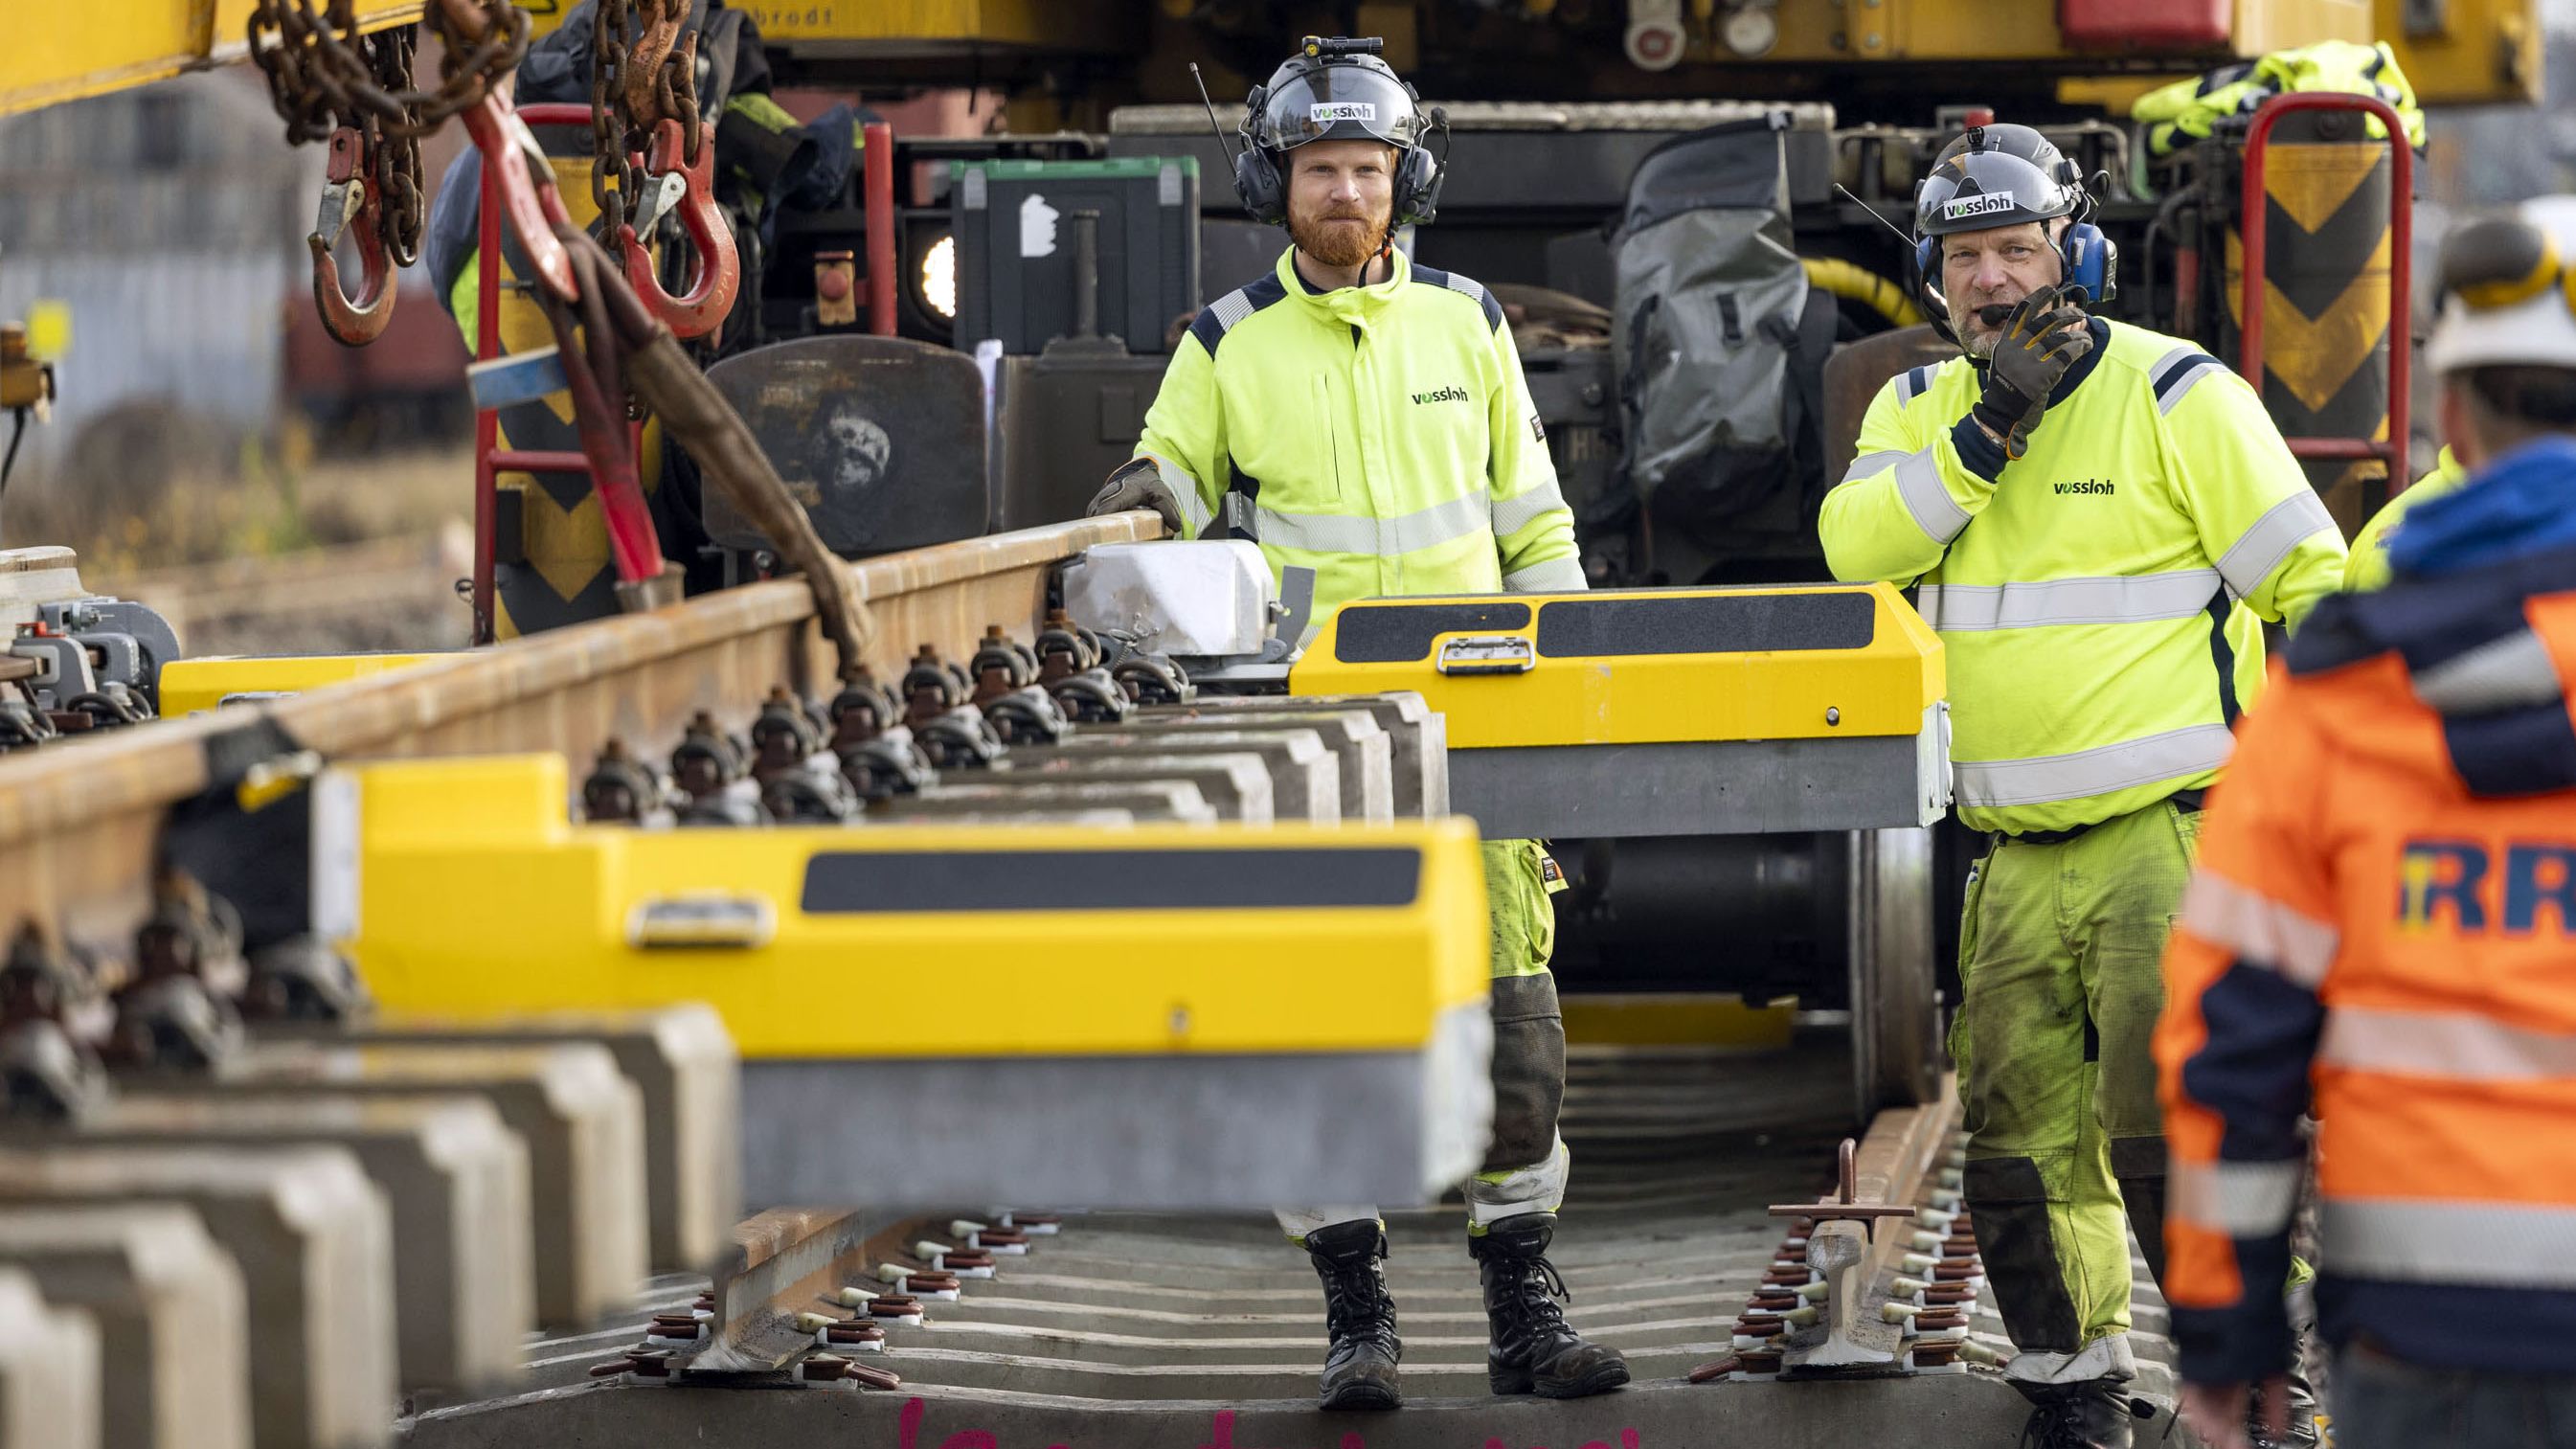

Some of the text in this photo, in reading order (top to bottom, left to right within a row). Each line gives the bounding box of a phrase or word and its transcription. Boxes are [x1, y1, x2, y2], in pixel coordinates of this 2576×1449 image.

[1312, 103, 1371, 120] vossloh
[1946, 193, 2011, 217] vossloh
[1412, 386, 1469, 405] vossloh
[2053, 478, 2115, 495] vossloh
